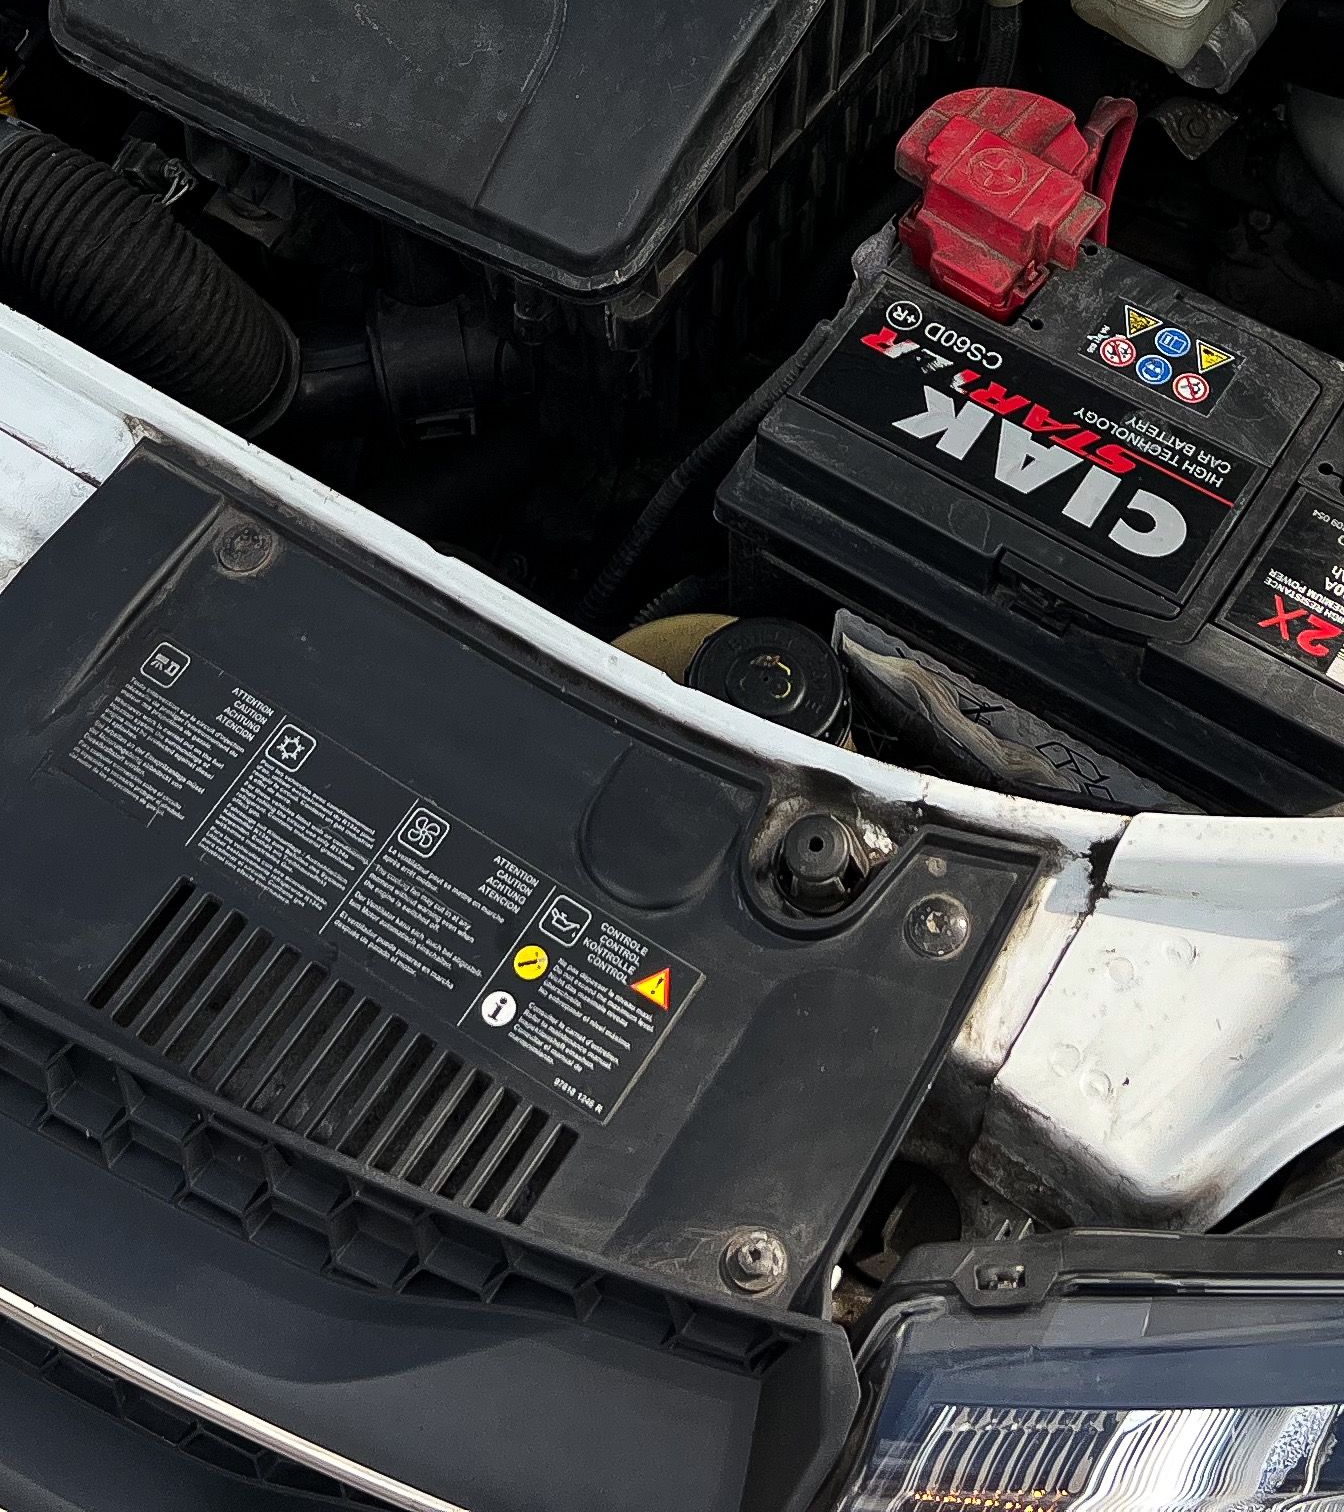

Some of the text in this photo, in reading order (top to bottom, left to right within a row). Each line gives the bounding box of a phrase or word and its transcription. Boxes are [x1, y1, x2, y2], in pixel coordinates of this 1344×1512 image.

[924, 322, 1002, 369] CS60D
[1073, 408, 1223, 487] HIGH TECHNOLOGY
[1125, 416, 1231, 473] CAR BATTERY
[891, 385, 1187, 558] CIAK
[1263, 576, 1324, 613] RESISTANCE
[1268, 568, 1307, 593] POWER
[1259, 597, 1341, 655] 2X
[231, 687, 274, 716] ATTENTION
[233, 699, 267, 724] CAUTION
[215, 714, 255, 741] ATENCION
[223, 706, 260, 732] ACHTUNG
[493, 855, 539, 886] ATTENTION
[496, 869, 533, 896] CAUTION
[477, 884, 520, 913] ATENCION
[485, 876, 526, 904] ACHTUNG
[599, 934, 639, 966] CONTROL
[600, 922, 648, 956] CONTROLE
[582, 937, 636, 975] KONTROLLE
[587, 953, 627, 984] CONTROL
